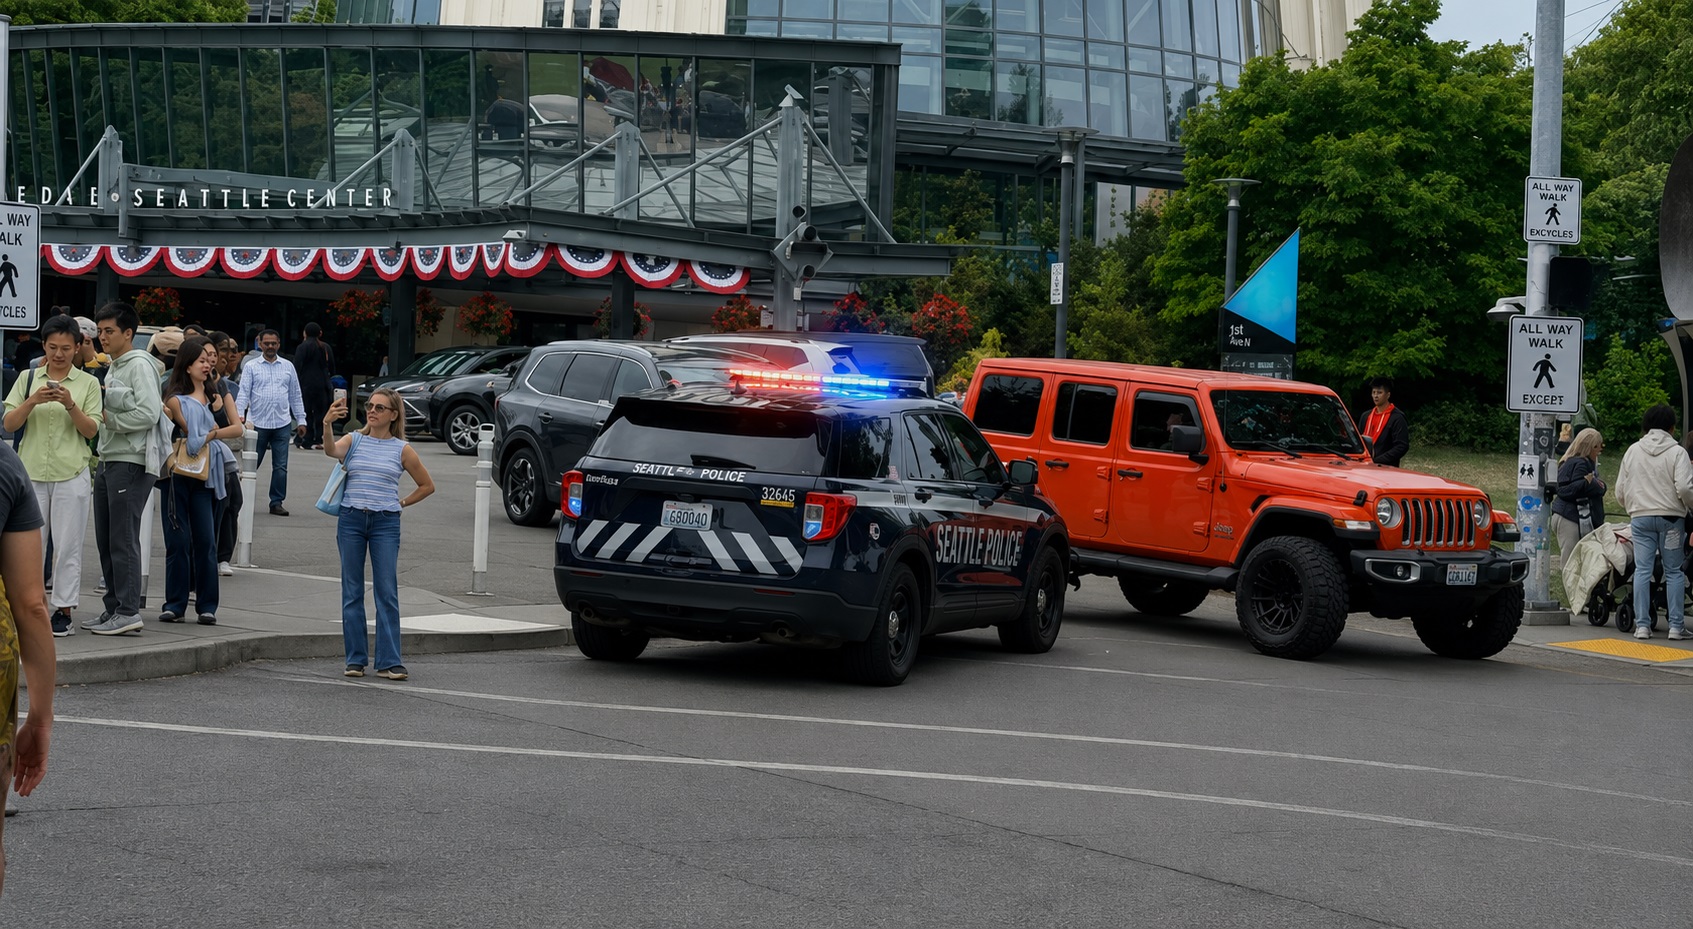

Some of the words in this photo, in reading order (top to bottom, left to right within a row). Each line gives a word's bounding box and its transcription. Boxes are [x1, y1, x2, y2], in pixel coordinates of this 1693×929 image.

[1532, 183, 1551, 191] ALL
[1554, 184, 1574, 192] WAY
[133, 188, 269, 208] SEATTLE
[287, 187, 392, 207] CENTER
[1540, 193, 1567, 202] WALK
[7, 212, 31, 227] WAY
[1530, 228, 1574, 239] EXCYCLES
[1519, 323, 1543, 334] ALL
[1547, 324, 1574, 335] WAY
[1528, 337, 1564, 349] WALK
[700, 468, 747, 482] POLICE
[762, 486, 795, 502] 32645
[936, 524, 983, 565] SEATTLE
[984, 528, 1022, 567] POLICE
